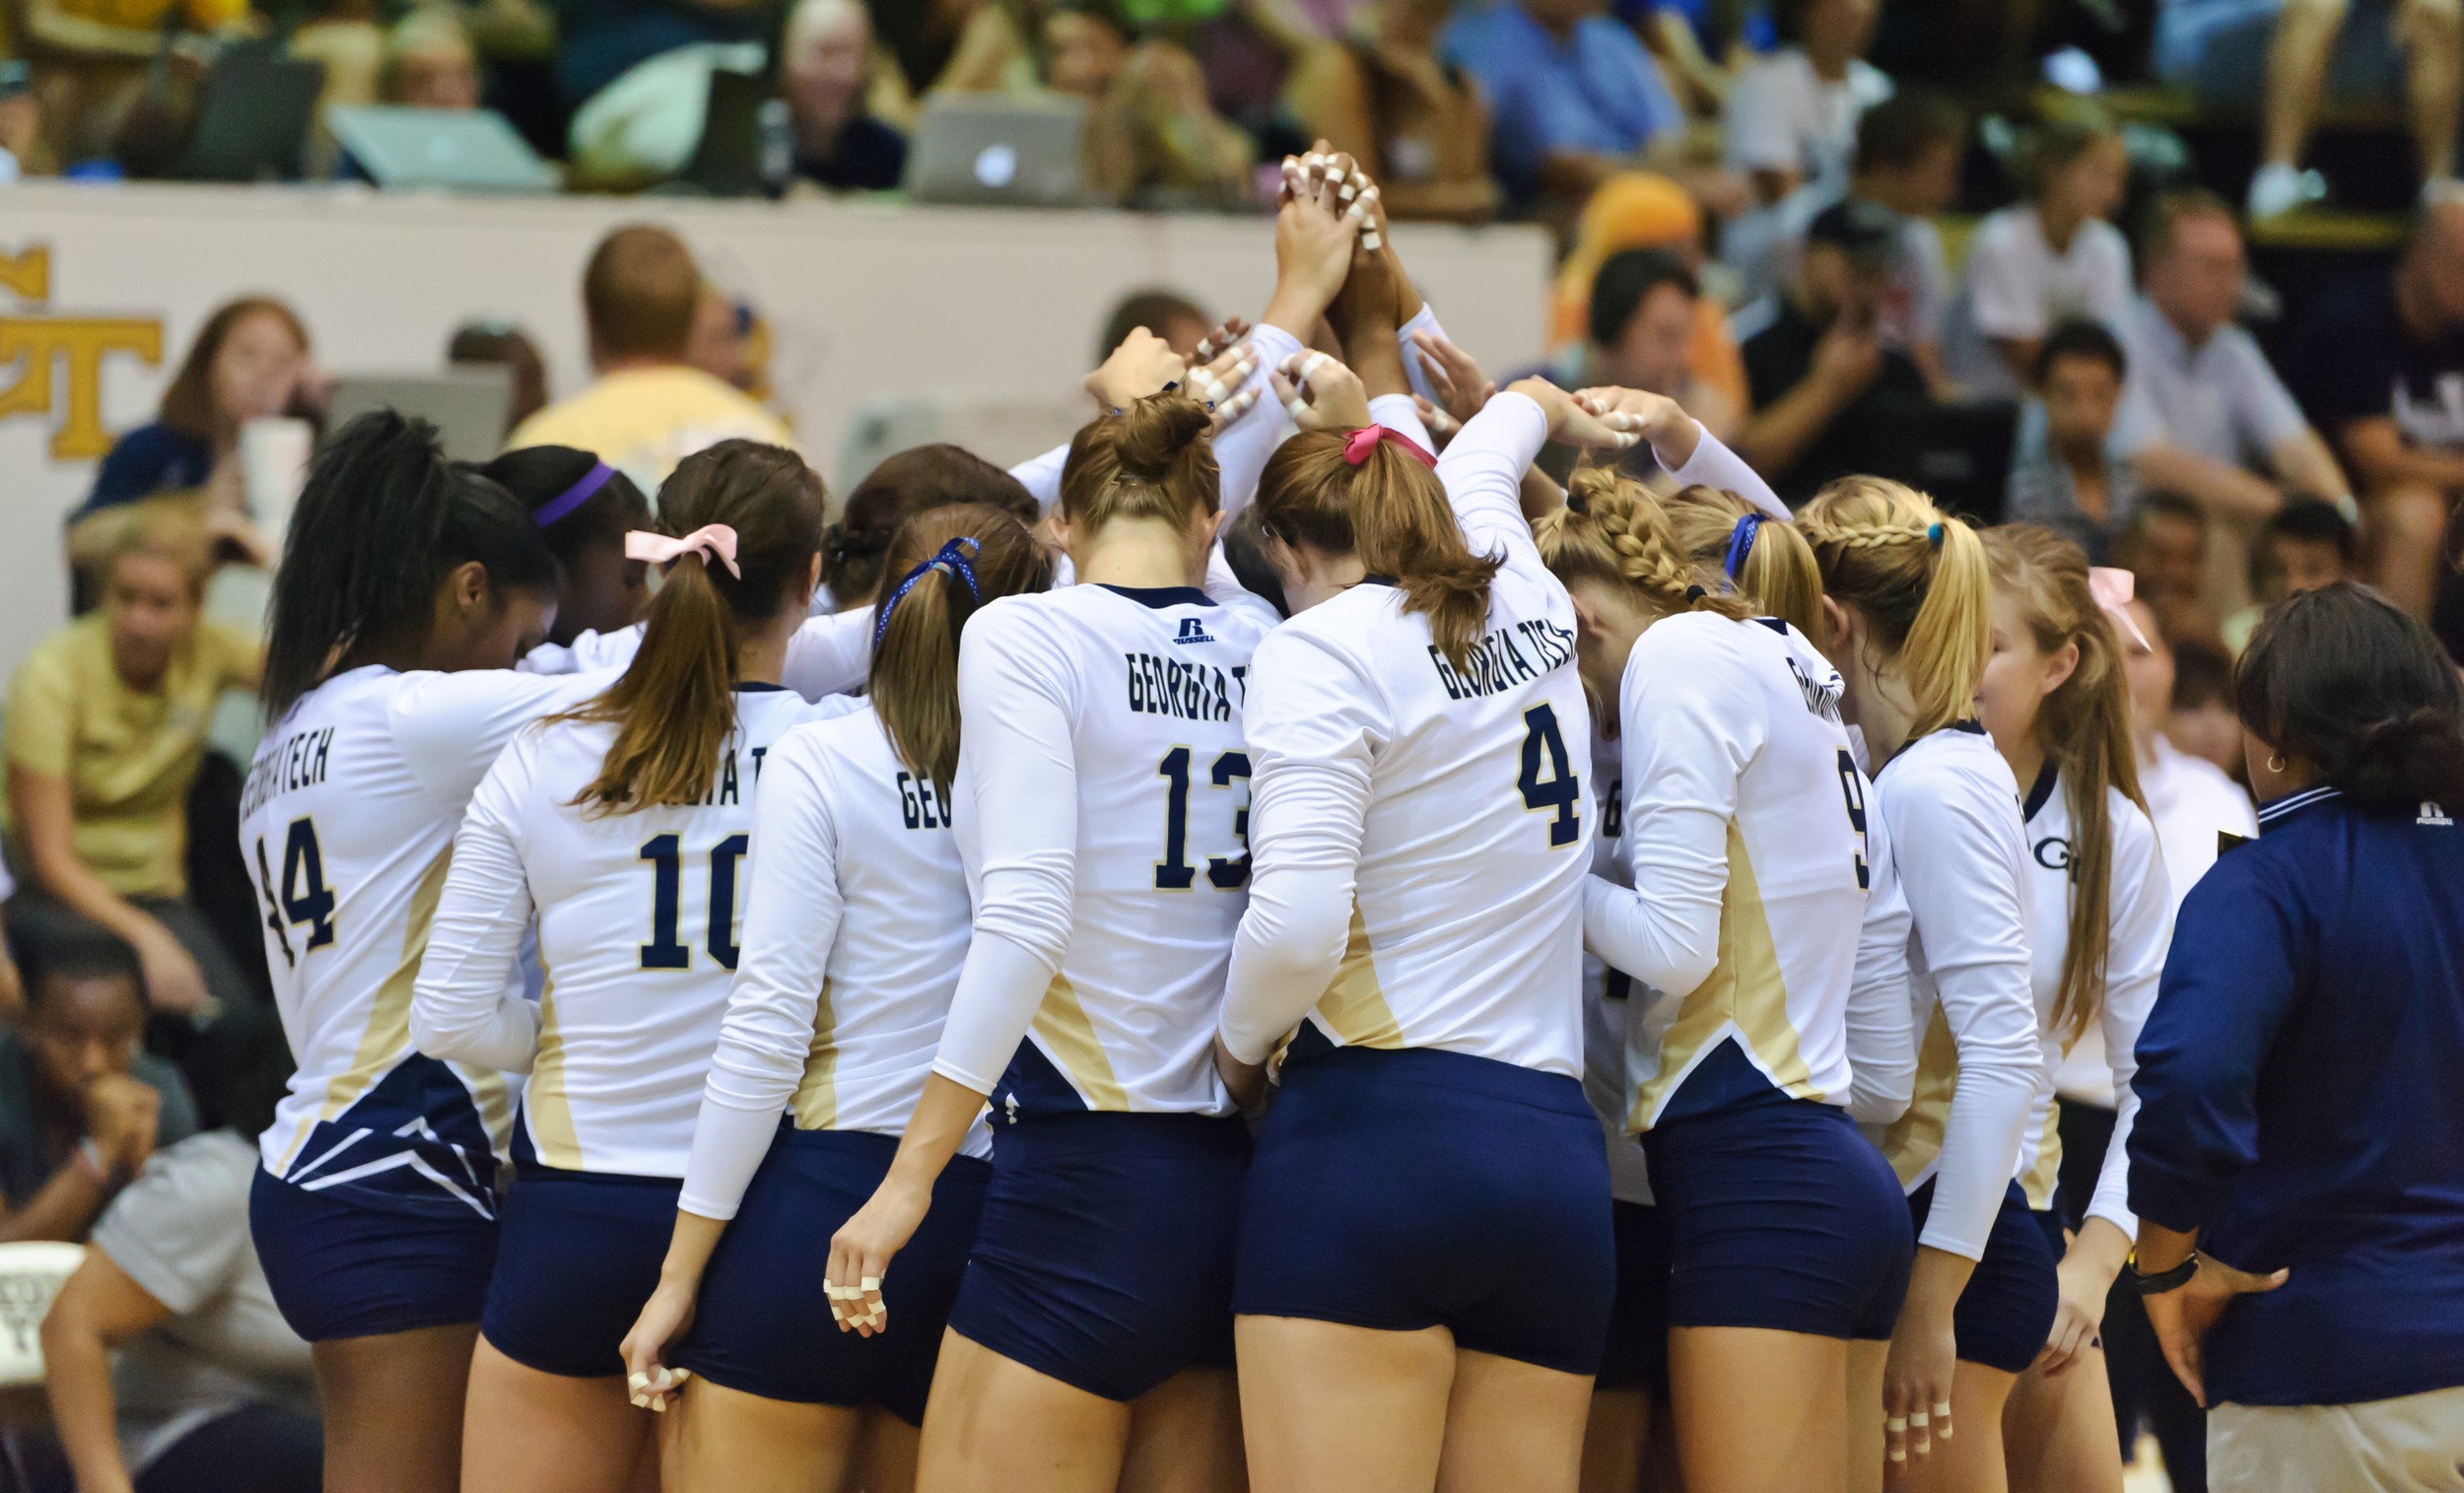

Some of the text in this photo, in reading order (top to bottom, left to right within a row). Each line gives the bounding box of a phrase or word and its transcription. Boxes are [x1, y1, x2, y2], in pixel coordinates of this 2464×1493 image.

[283, 727, 334, 790] TECH
[1126, 653, 1232, 721] GEORGIA
[897, 772, 952, 829] GEO
[1152, 743, 1253, 893] 13
[1514, 698, 1582, 852] 4
[1836, 745, 1870, 894] 9
[636, 830, 749, 973] 10
